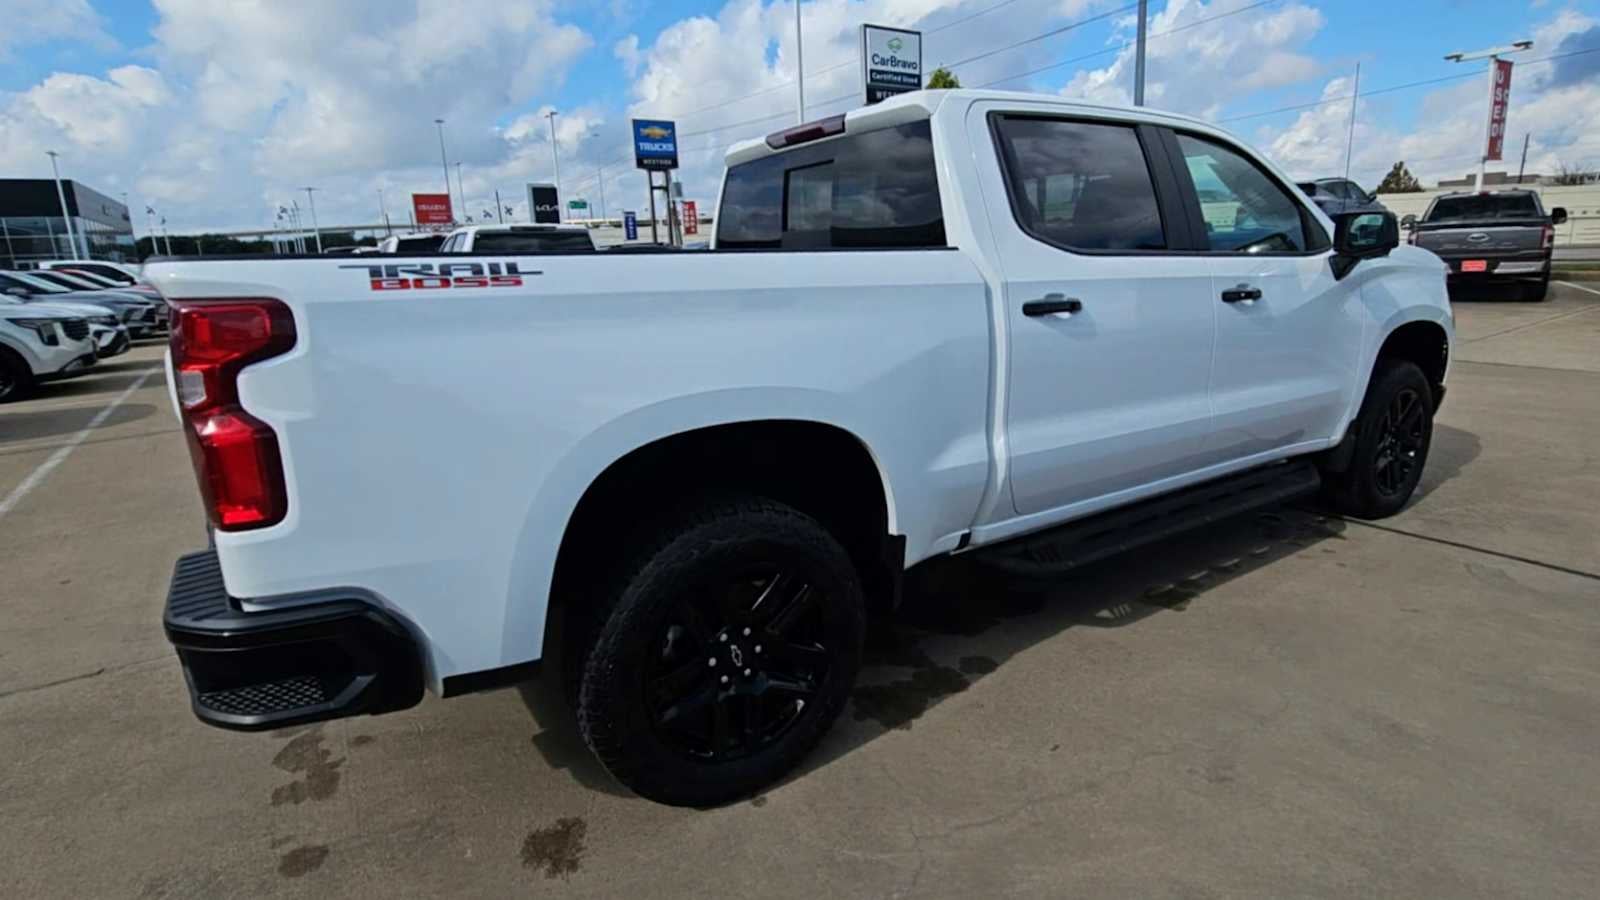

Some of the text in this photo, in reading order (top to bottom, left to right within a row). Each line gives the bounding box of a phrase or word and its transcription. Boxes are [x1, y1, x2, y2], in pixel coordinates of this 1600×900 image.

[872, 53, 918, 70] CarBravo
[872, 72, 919, 84] Certified Used
[1491, 69, 1505, 138] USED
[639, 142, 675, 152] TRUCKS
[338, 262, 543, 278] TRAIL
[371, 277, 523, 290] BOSS
